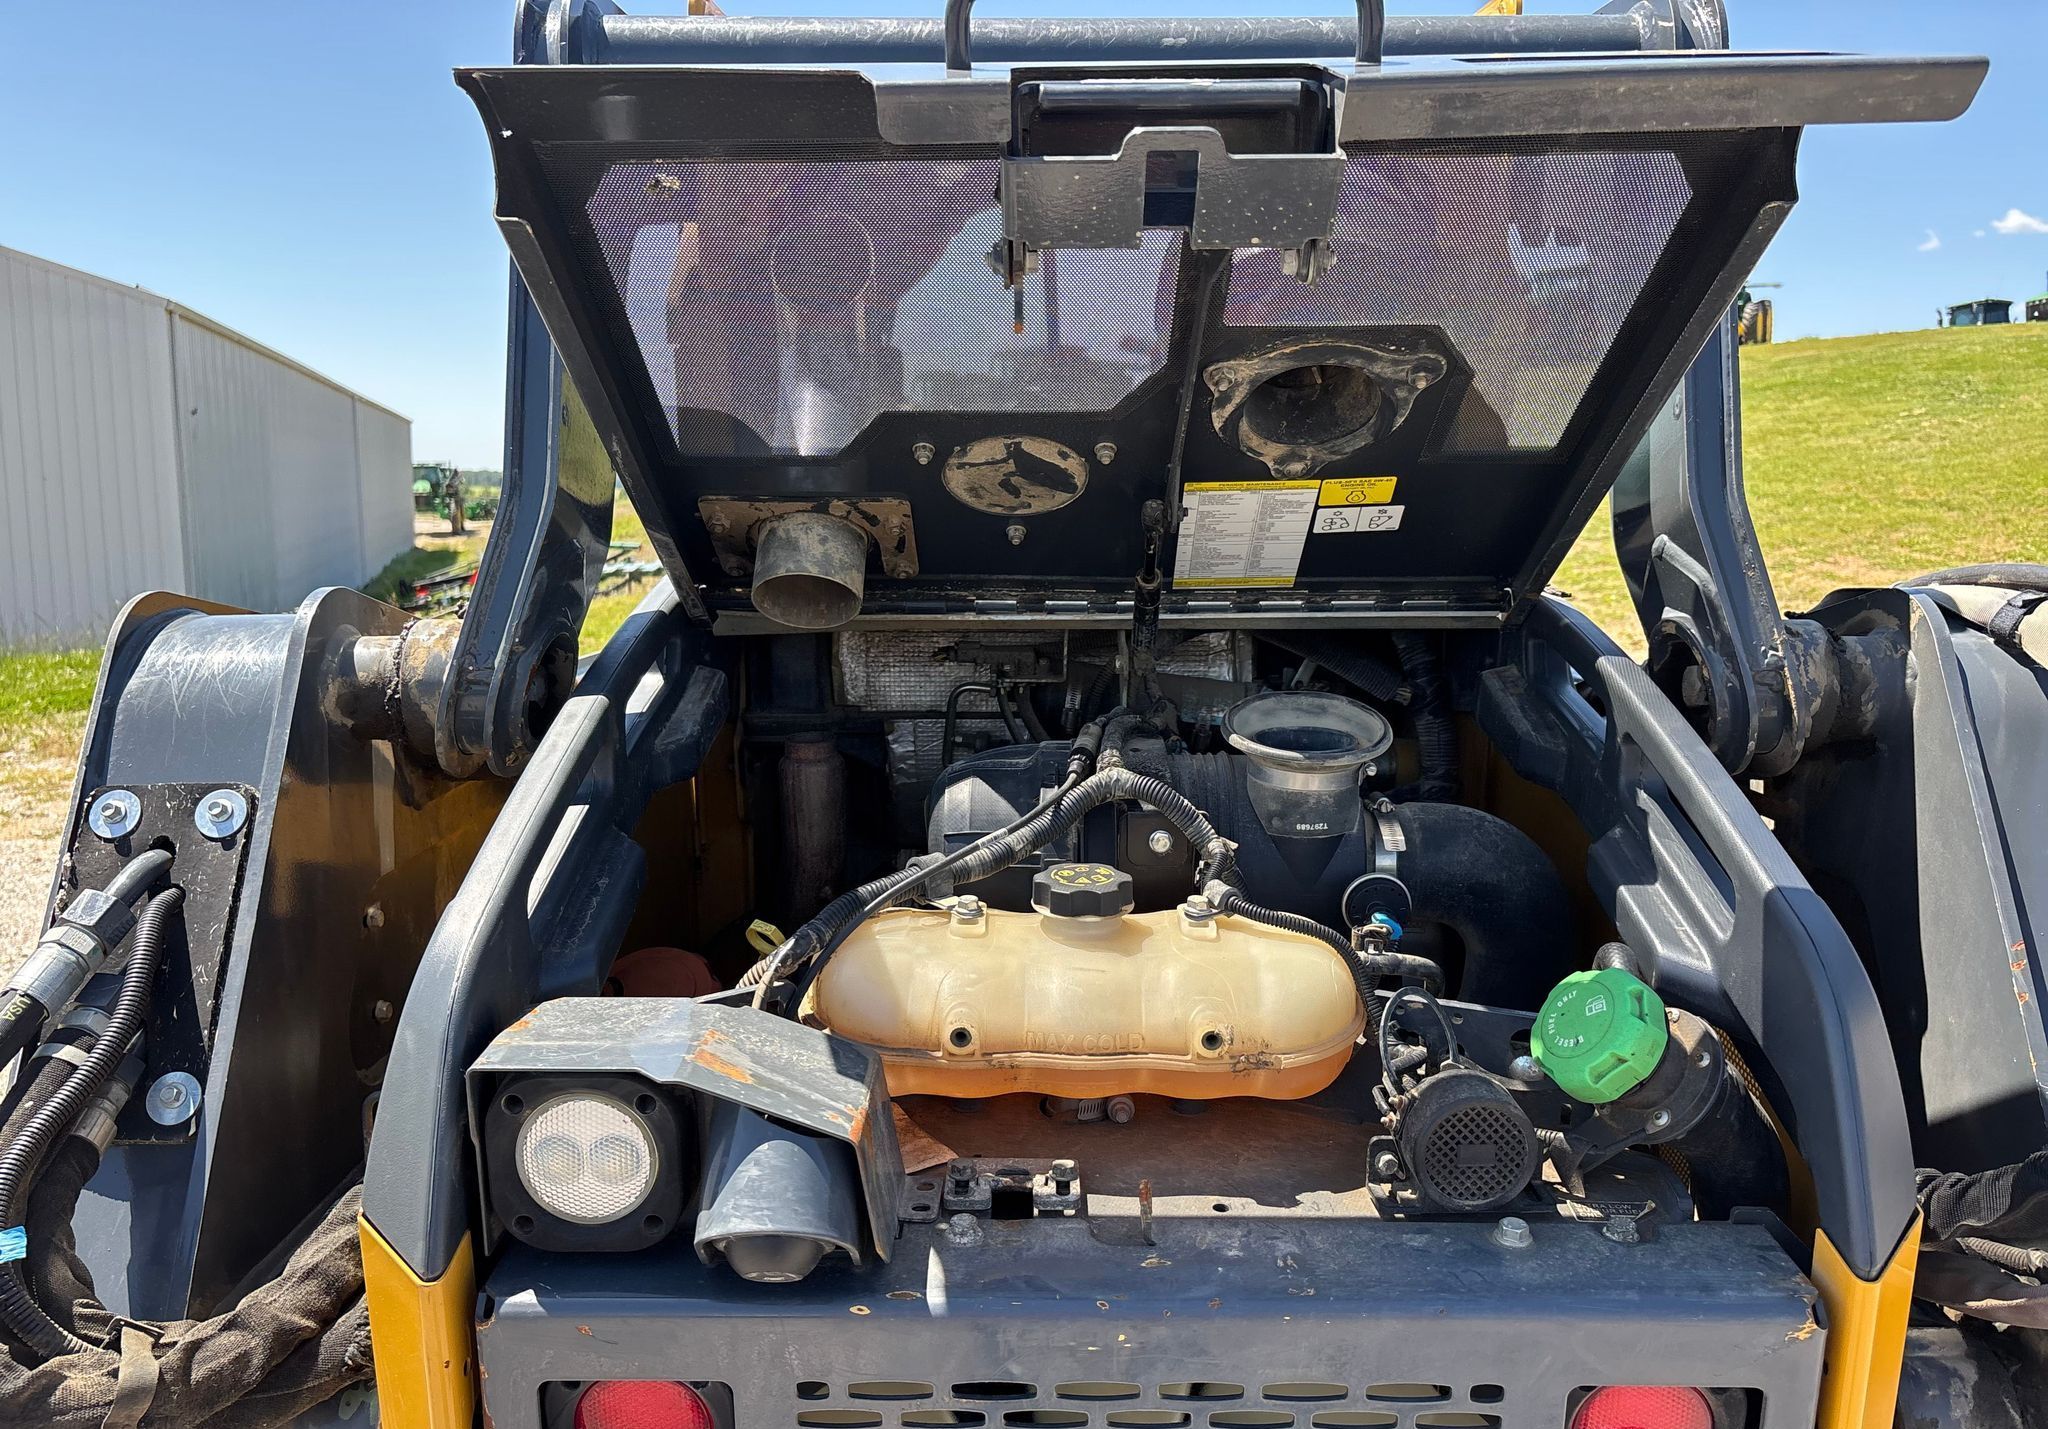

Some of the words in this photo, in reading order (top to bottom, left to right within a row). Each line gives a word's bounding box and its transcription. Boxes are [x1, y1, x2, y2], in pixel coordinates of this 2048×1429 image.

[1296, 822, 1329, 831] T297689
[2, 996, 31, 1021] USA
[1557, 990, 1577, 1008] ONLY
[1547, 1012, 1557, 1035] FUEL
[1025, 1031, 1078, 1051] MAX
[1083, 1032, 1146, 1052] COLD
[1554, 1035, 1585, 1048] DIESEL
